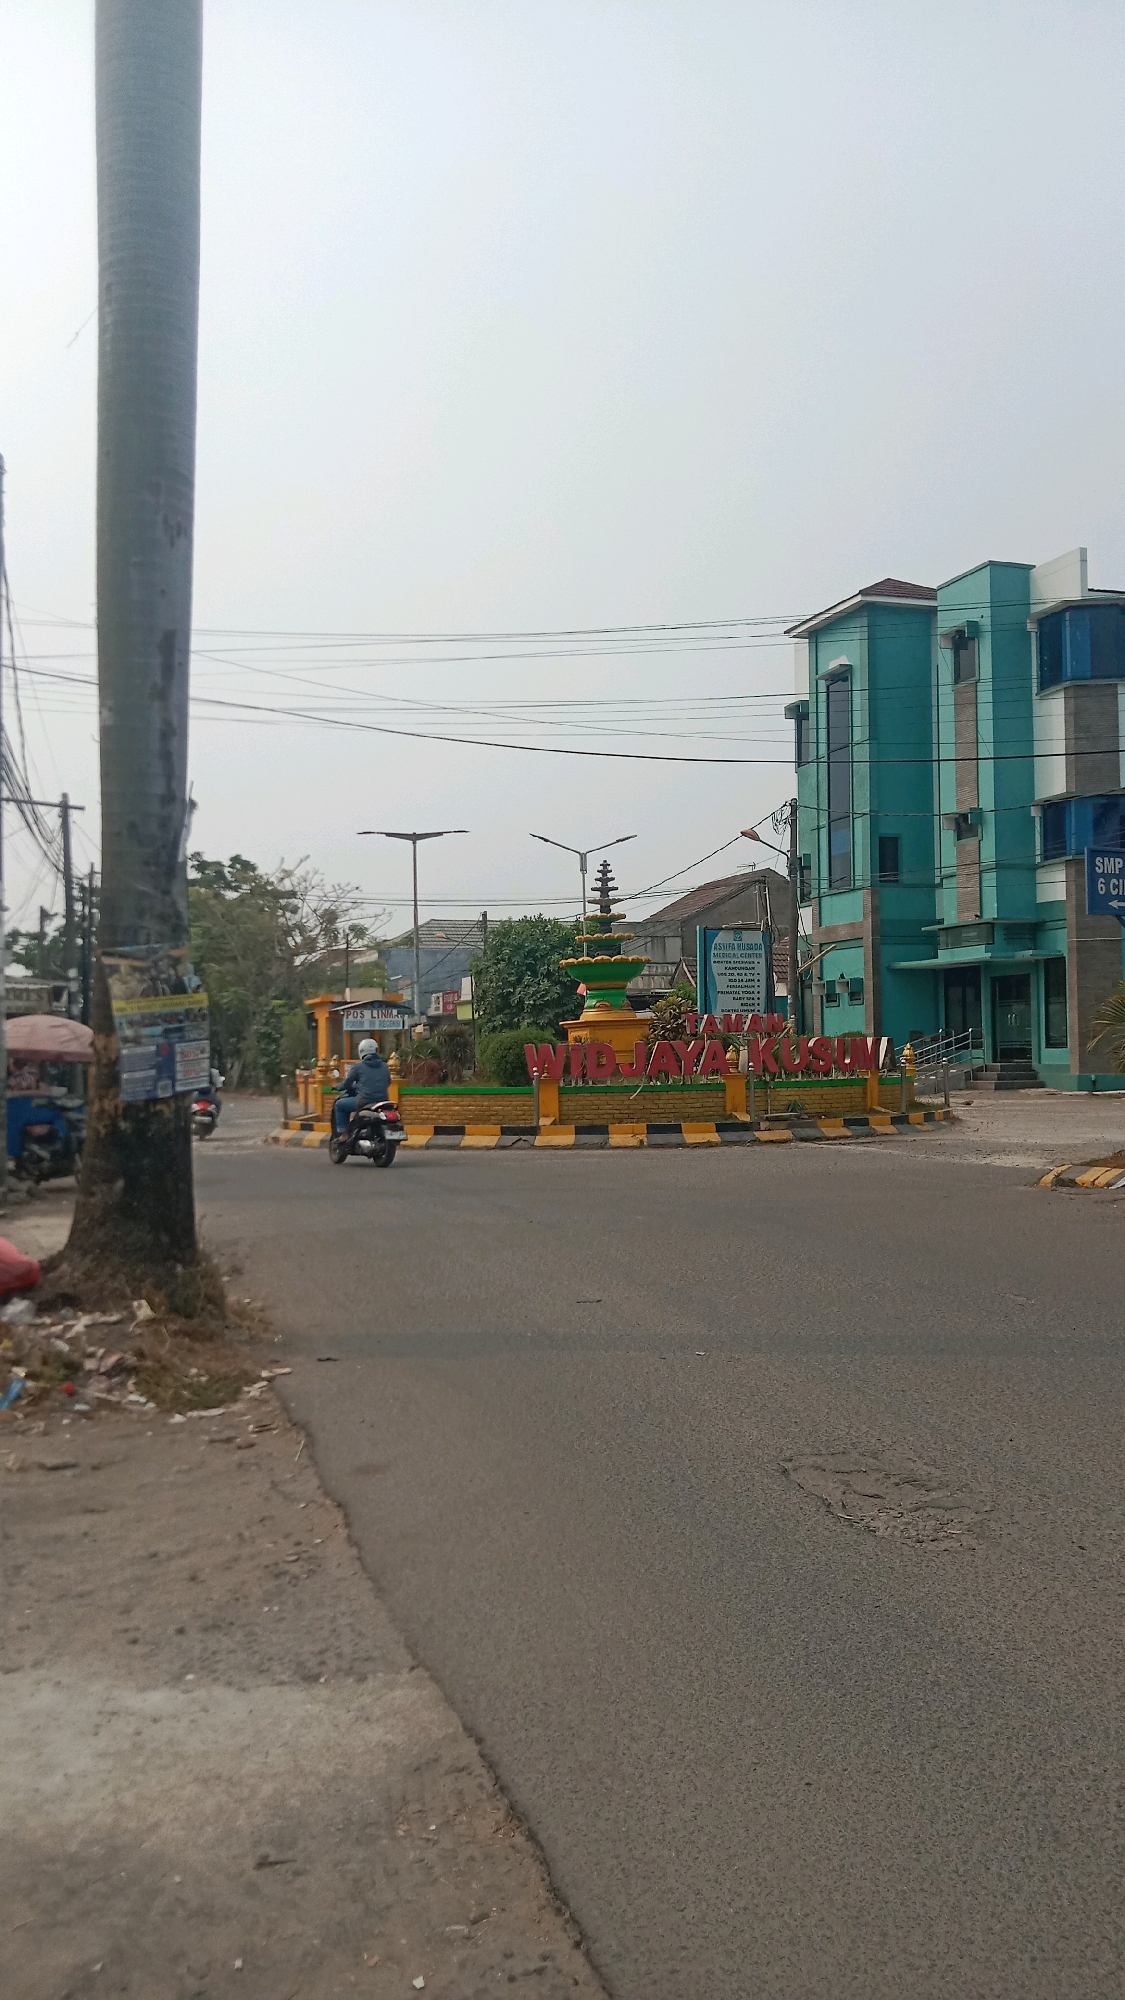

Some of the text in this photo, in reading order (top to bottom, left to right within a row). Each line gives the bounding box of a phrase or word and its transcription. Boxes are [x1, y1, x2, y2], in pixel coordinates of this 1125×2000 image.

[1095, 856, 1124, 874] SMP
[1097, 877, 1125, 896] 6 CI
[737, 942, 763, 951] HUSADA
[345, 1010, 365, 1019] POS
[683, 1013, 784, 1036] TAMAN
[523, 1036, 896, 1079] WIDJAYA KUSUMA
